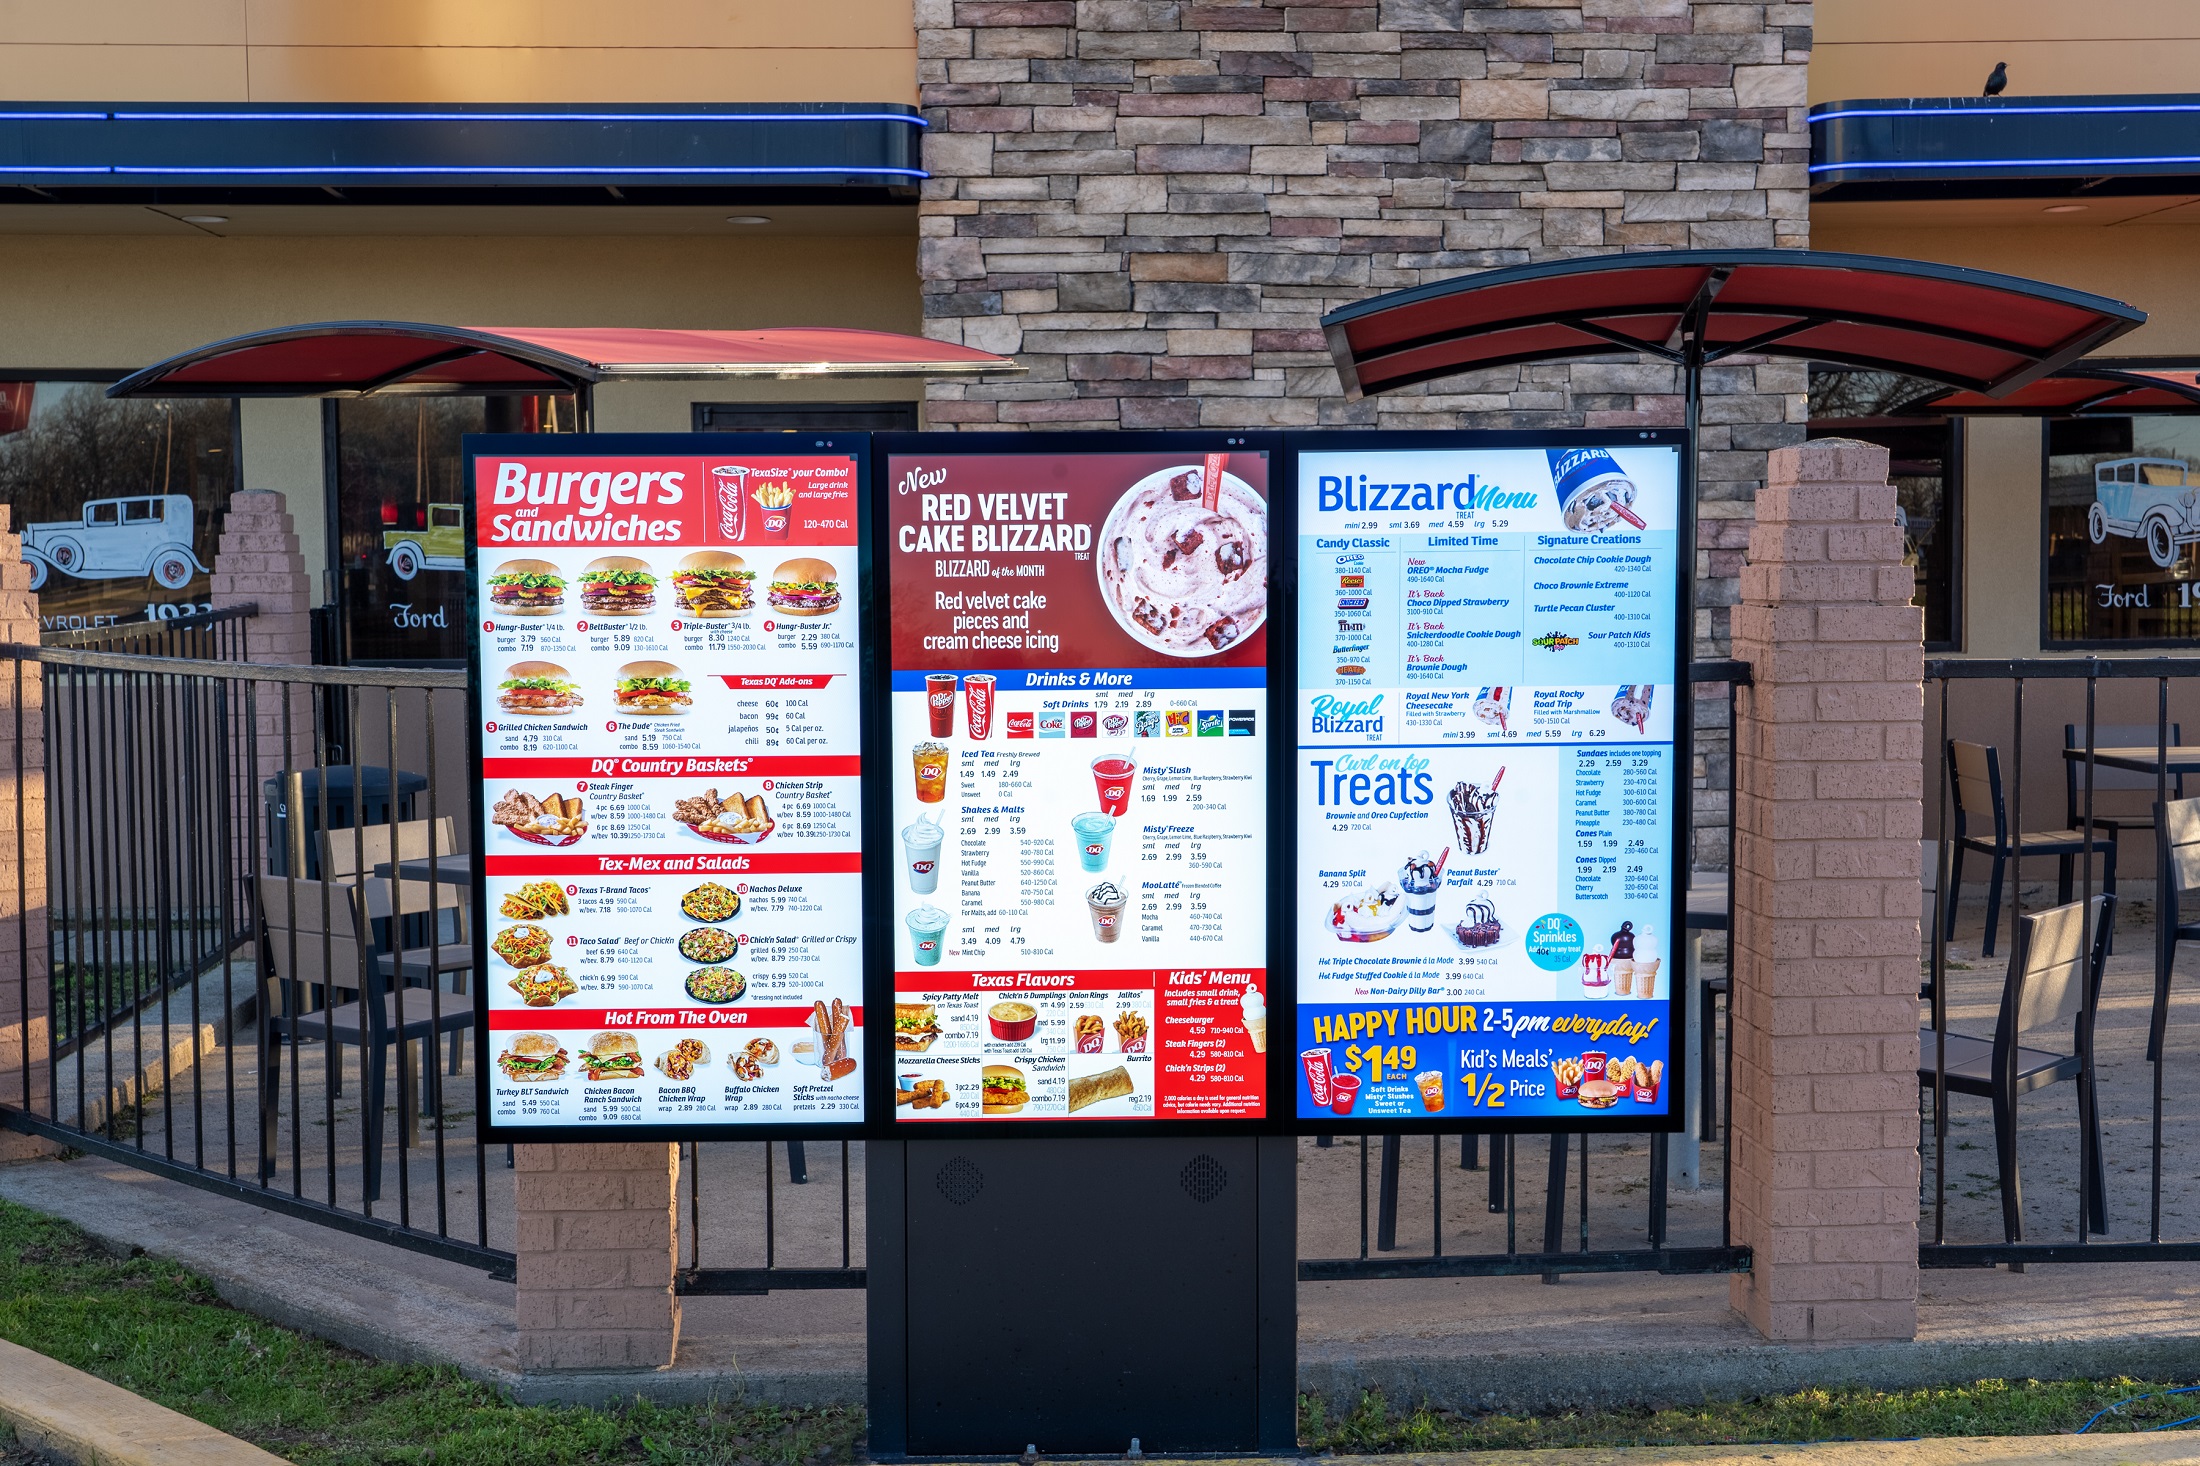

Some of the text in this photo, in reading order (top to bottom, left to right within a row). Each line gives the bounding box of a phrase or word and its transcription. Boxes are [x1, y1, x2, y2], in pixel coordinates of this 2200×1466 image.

[791, 469, 814, 479] your
[815, 467, 848, 477] Combo!
[808, 481, 848, 490] Large drink
[898, 466, 947, 495] New
[494, 462, 685, 516] Burgers
[1318, 474, 1538, 512] Blizzard Menu
[813, 491, 832, 500] large
[832, 491, 848, 500] fries
[922, 492, 1068, 521] RED VELVET
[515, 506, 538, 518] and
[1455, 511, 1475, 520] TREAT
[491, 515, 682, 543] Sandwiches
[803, 520, 848, 529] 120-470 Cal
[1361, 519, 1509, 530] 2.99 3.69 4.59 5.29
[899, 523, 1092, 553] CAKE BLIZZARD
[1428, 536, 1498, 546] Limited Time
[1537, 534, 1642, 547] Signature Creations
[1316, 538, 1390, 550] Candy Classic
[1074, 553, 1090, 561] TREAT
[1534, 556, 1575, 564] Chocolate
[1576, 556, 1594, 565] Chip
[1625, 555, 1651, 564] Dough
[935, 559, 1045, 577] BLIZZARD of the MONTH
[935, 590, 1047, 610] Red velvet cake
[2095, 583, 2151, 608] Ford
[389, 602, 450, 629] Ford
[954, 611, 1029, 633] pieces and
[521, 635, 536, 643] 3.79
[708, 634, 725, 642] 8.30
[1406, 630, 1521, 639] Snickerdoodle Cookie Dough
[923, 630, 1059, 653] cream cheese icing
[521, 644, 534, 652] 7.19
[740, 678, 763, 686] Texas
[779, 677, 813, 686] Add-ons
[1025, 672, 1133, 687] Drinks & More
[737, 700, 759, 708] cheese
[1043, 700, 1152, 709] Soft Drinks 1.79 2.19 2.89
[1310, 694, 1384, 723] Royal
[1406, 702, 1453, 710] Cheesecake
[739, 712, 759, 720] bacon
[498, 723, 588, 731] Grilled Chicken Sandwich
[1312, 715, 1383, 733] Blizzard
[728, 725, 759, 734] jalapeños
[523, 734, 538, 742] 4.79
[745, 737, 759, 745] chili
[961, 750, 995, 758] Iced Tea
[1576, 749, 1608, 757] Sundaes
[621, 758, 683, 776] Country
[1335, 753, 1430, 775] Curl on top
[1143, 766, 1192, 775] Misty Slush
[1310, 760, 1434, 806] Treats
[961, 806, 991, 814] Shakes
[1389, 812, 1428, 820] Cupfection
[960, 827, 1026, 835] 2.69 2.99 3.59
[598, 856, 751, 871] Tex-Mex and Salads
[1349, 870, 1366, 878] Split
[749, 885, 803, 893] Nachos Deluxe
[1533, 931, 1577, 945] Sprinkles
[972, 973, 1075, 987] Texas Flavors
[1168, 971, 1251, 985] Kids' Menu
[922, 993, 942, 1002] Spicy
[942, 993, 962, 1001] Patty
[1164, 989, 1240, 998] Includes small drink,
[605, 1010, 748, 1025] Hot From The Oven
[1165, 1016, 1214, 1024] Cheeseburger
[1313, 1009, 1399, 1044] HAPPY
[1406, 1005, 1478, 1035] HOUR
[1551, 1013, 1659, 1045] everyday!
[897, 1057, 935, 1065] Mozzarella
[961, 1056, 981, 1064] Sticks
[1460, 1048, 1553, 1069] Kid's Meals'
[496, 1089, 519, 1097] Turkey
[793, 1085, 808, 1094] Soft
[1509, 1079, 1546, 1097] Price
